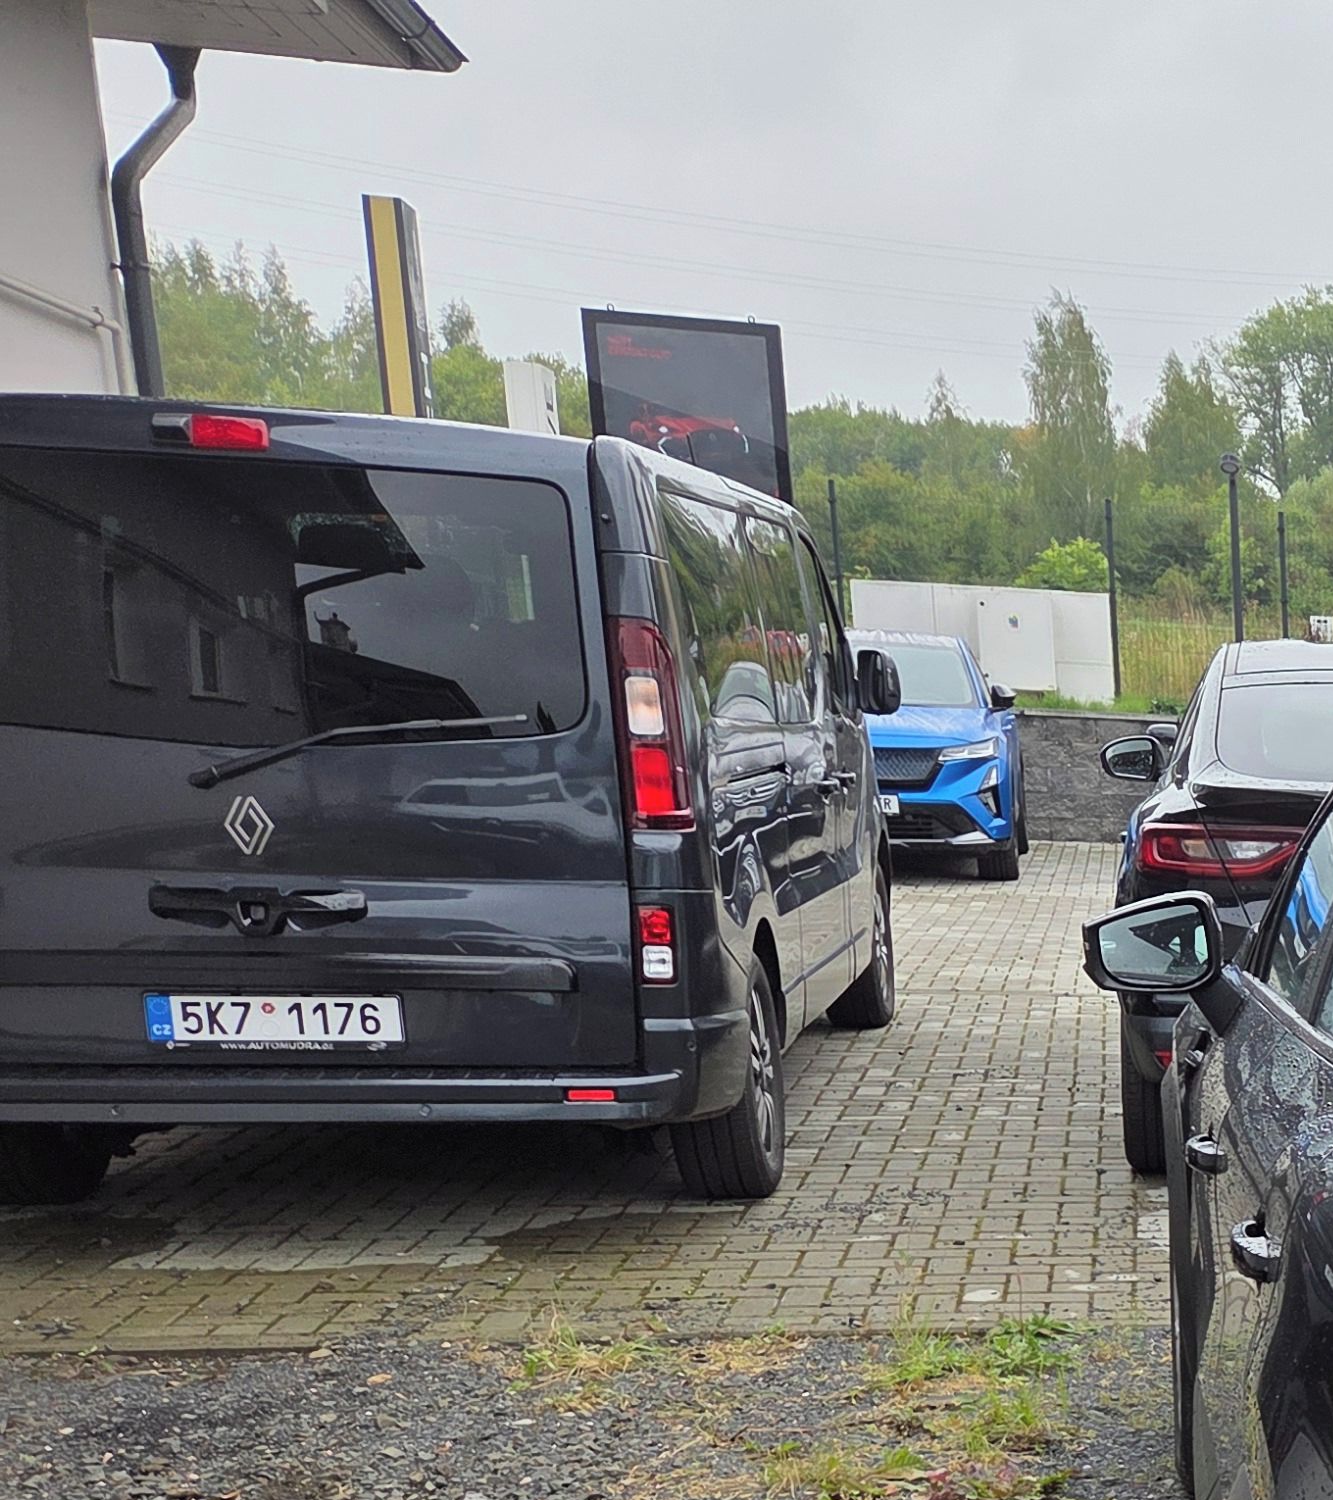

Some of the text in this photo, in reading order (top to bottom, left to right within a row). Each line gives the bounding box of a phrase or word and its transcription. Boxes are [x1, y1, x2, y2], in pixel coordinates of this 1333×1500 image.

[180, 1001, 382, 1035] 5K7 1176
[152, 1024, 172, 1036] CZ
